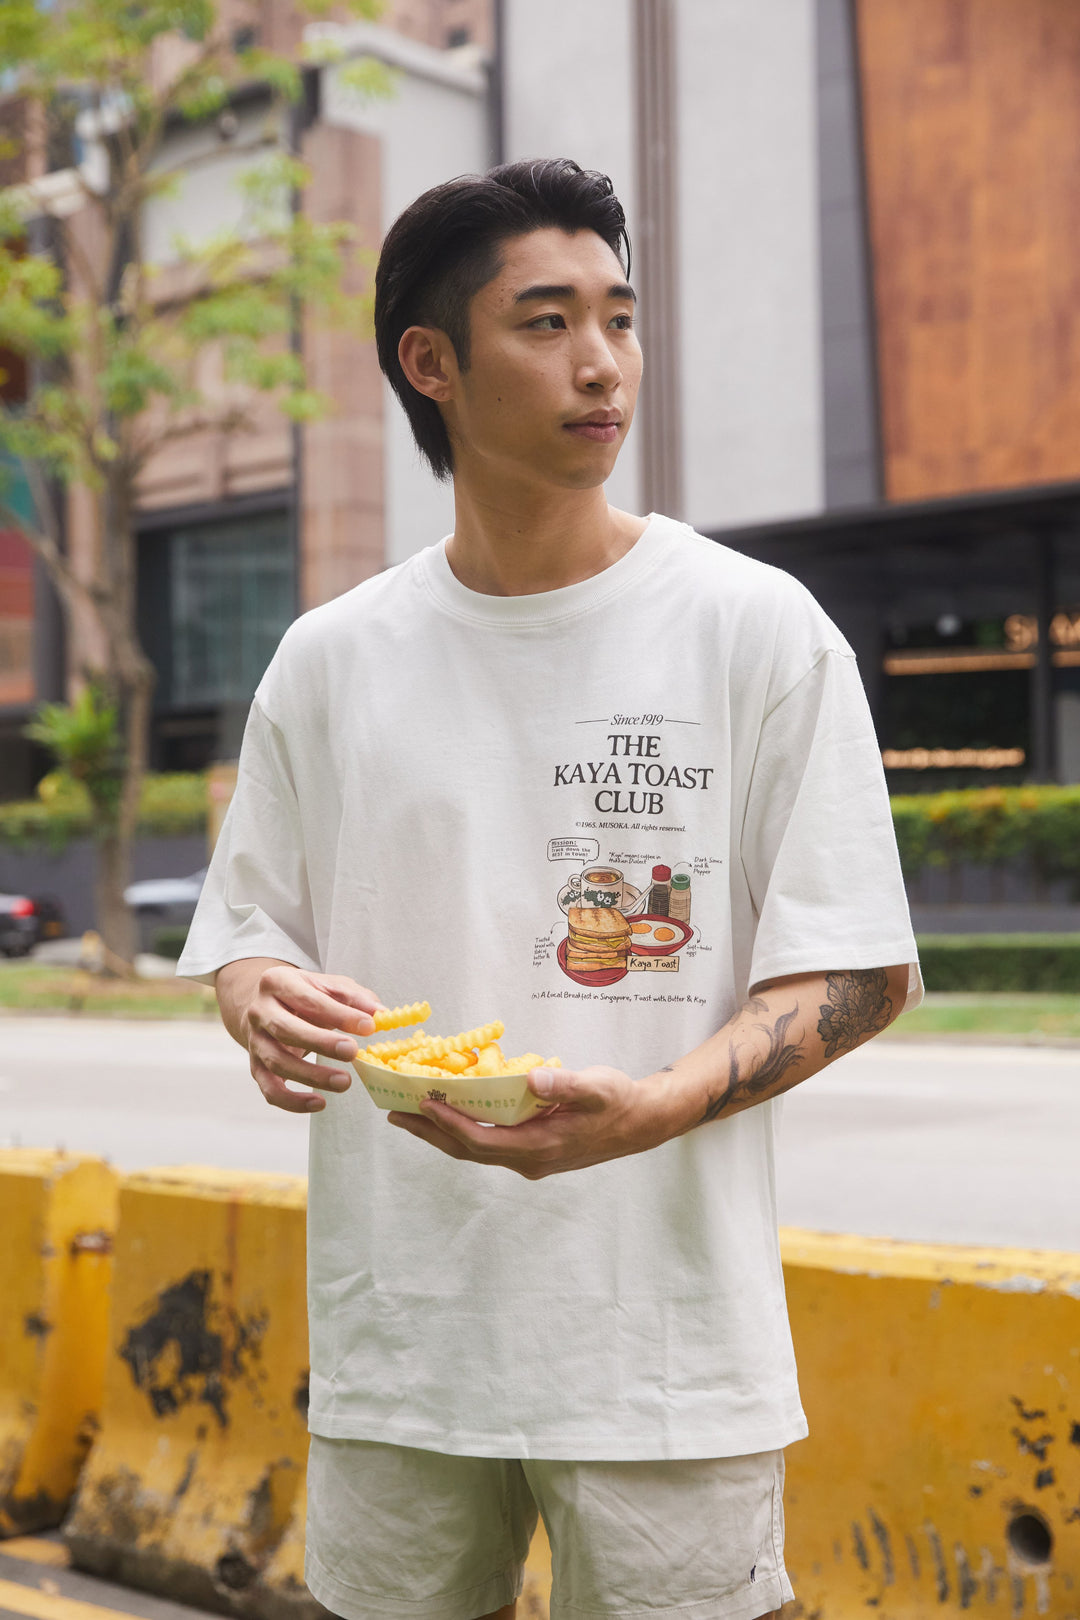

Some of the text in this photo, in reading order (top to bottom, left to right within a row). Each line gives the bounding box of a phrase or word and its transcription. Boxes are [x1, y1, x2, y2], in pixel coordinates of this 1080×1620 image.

[610, 714, 664, 726] Since 1919
[607, 735, 661, 757] THE
[553, 762, 714, 790] KAYA TOAST
[594, 790, 664, 815] CLUB
[641, 823, 658, 832] rights
[630, 958, 677, 972] Kaya Toast
[541, 991, 546, 999] A
[547, 991, 563, 999] Local
[563, 991, 592, 1000] Breakfast
[600, 993, 632, 1003] Singapore,
[634, 994, 652, 1002] Toast
[667, 995, 685, 1003] Butter
[686, 995, 693, 1003] &
[694, 996, 707, 1006] Kaya
